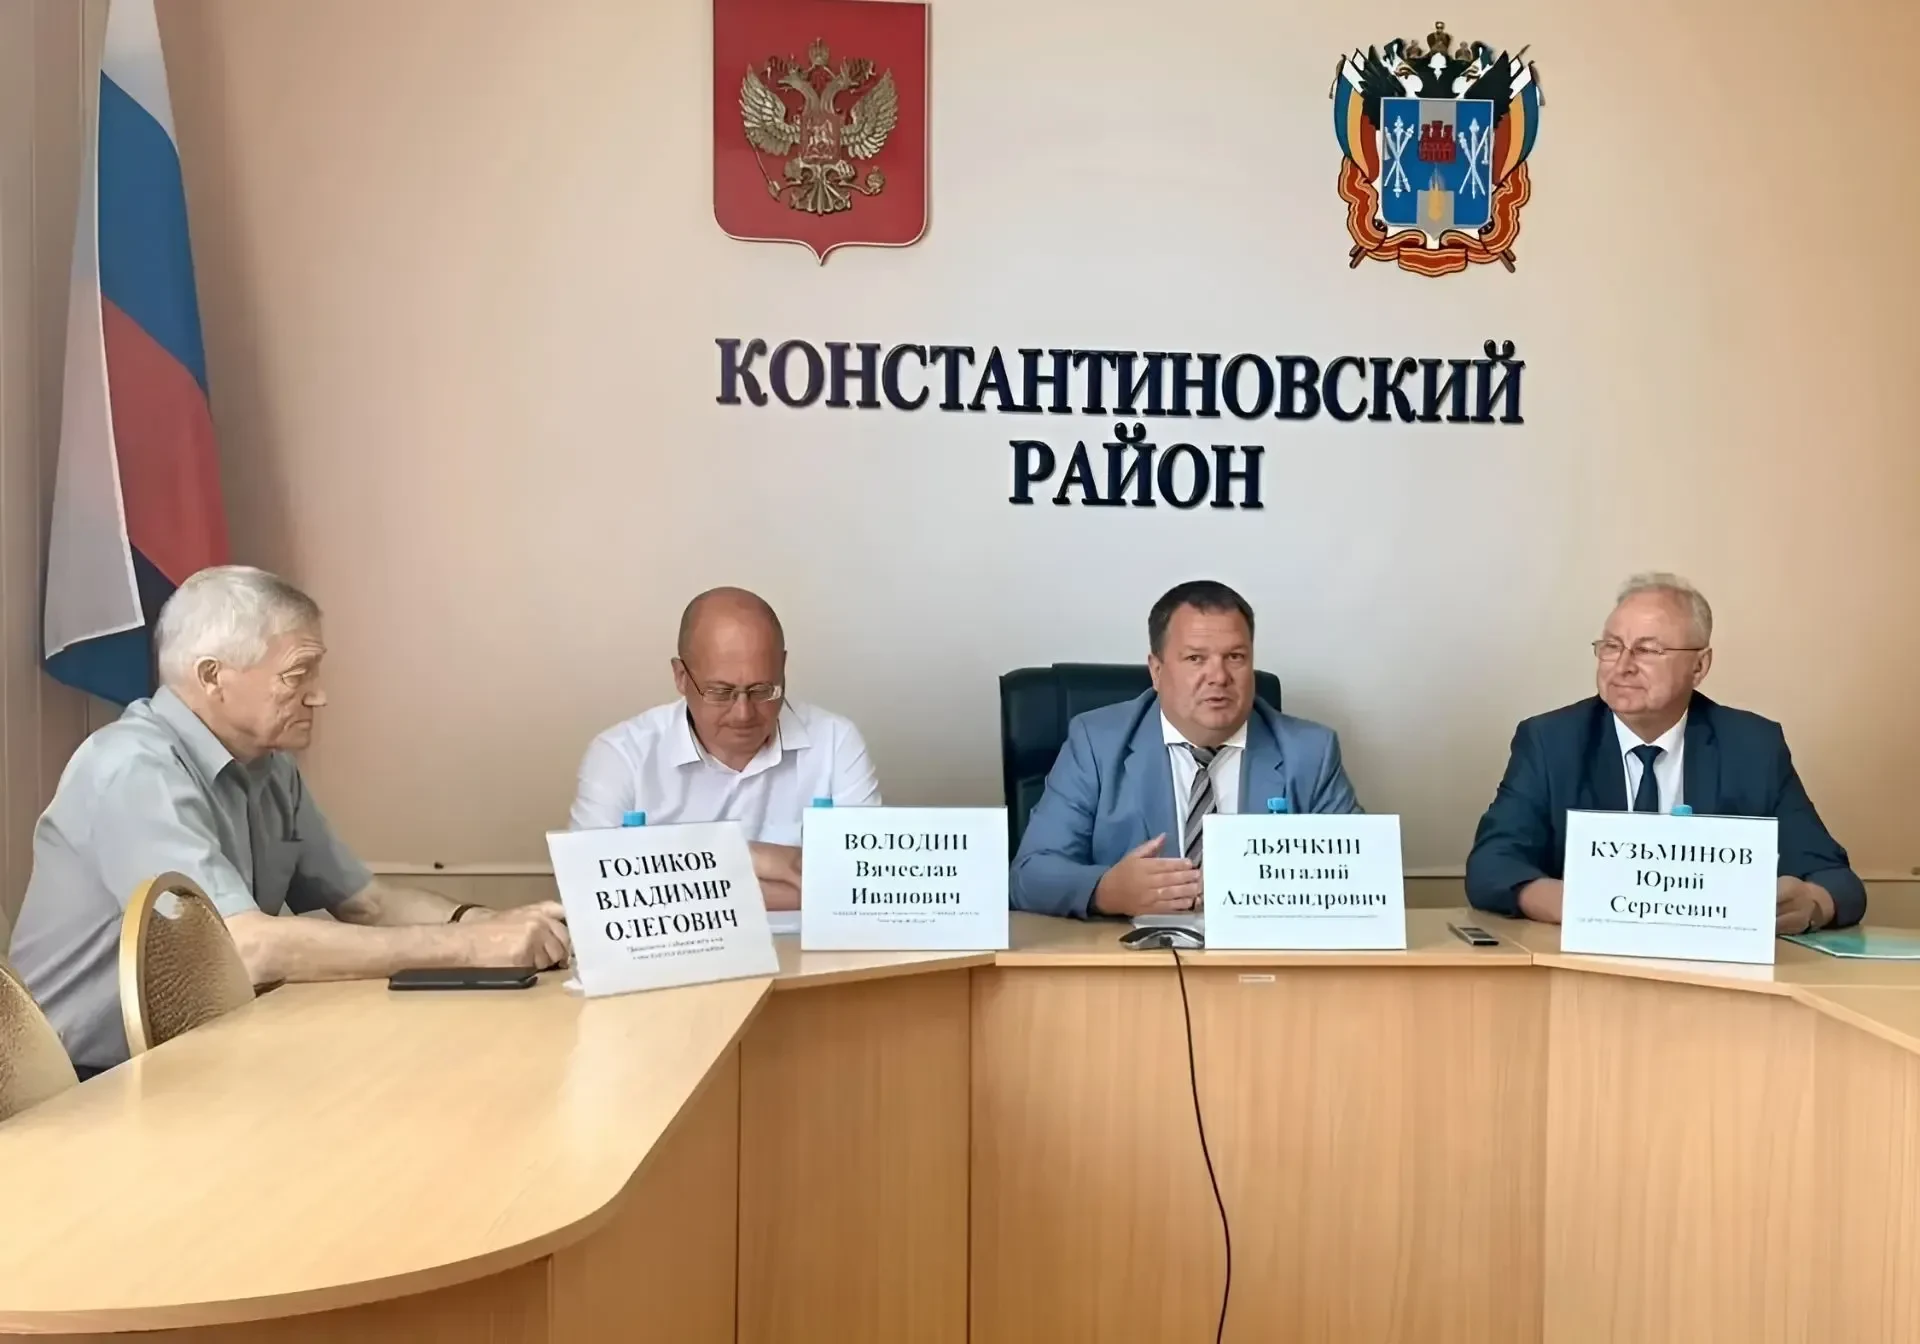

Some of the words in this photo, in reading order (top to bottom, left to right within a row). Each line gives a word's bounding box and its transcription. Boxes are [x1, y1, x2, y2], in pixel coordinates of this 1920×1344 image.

[714, 337, 1525, 424] КОНСТАНТИНОВСКИЙ
[1008, 421, 1266, 509] РАЙОН
[845, 833, 967, 851] ВОЛОДИН
[1243, 838, 1360, 856] ДЬЯЧКИН
[1591, 841, 1753, 864] КУЗЬМИНОВ
[599, 852, 717, 878] ГОЛИКОВ
[856, 861, 957, 877] Вячеслав
[1259, 864, 1348, 880] Виталий
[1636, 870, 1704, 892] Юрий
[596, 879, 731, 910] ВЛАДИМИР
[852, 888, 960, 904] Иванович
[1223, 890, 1386, 909] Александрович
[1610, 895, 1727, 918] Сергеевич
[605, 909, 738, 941] ОЛЕГОВИЧ
